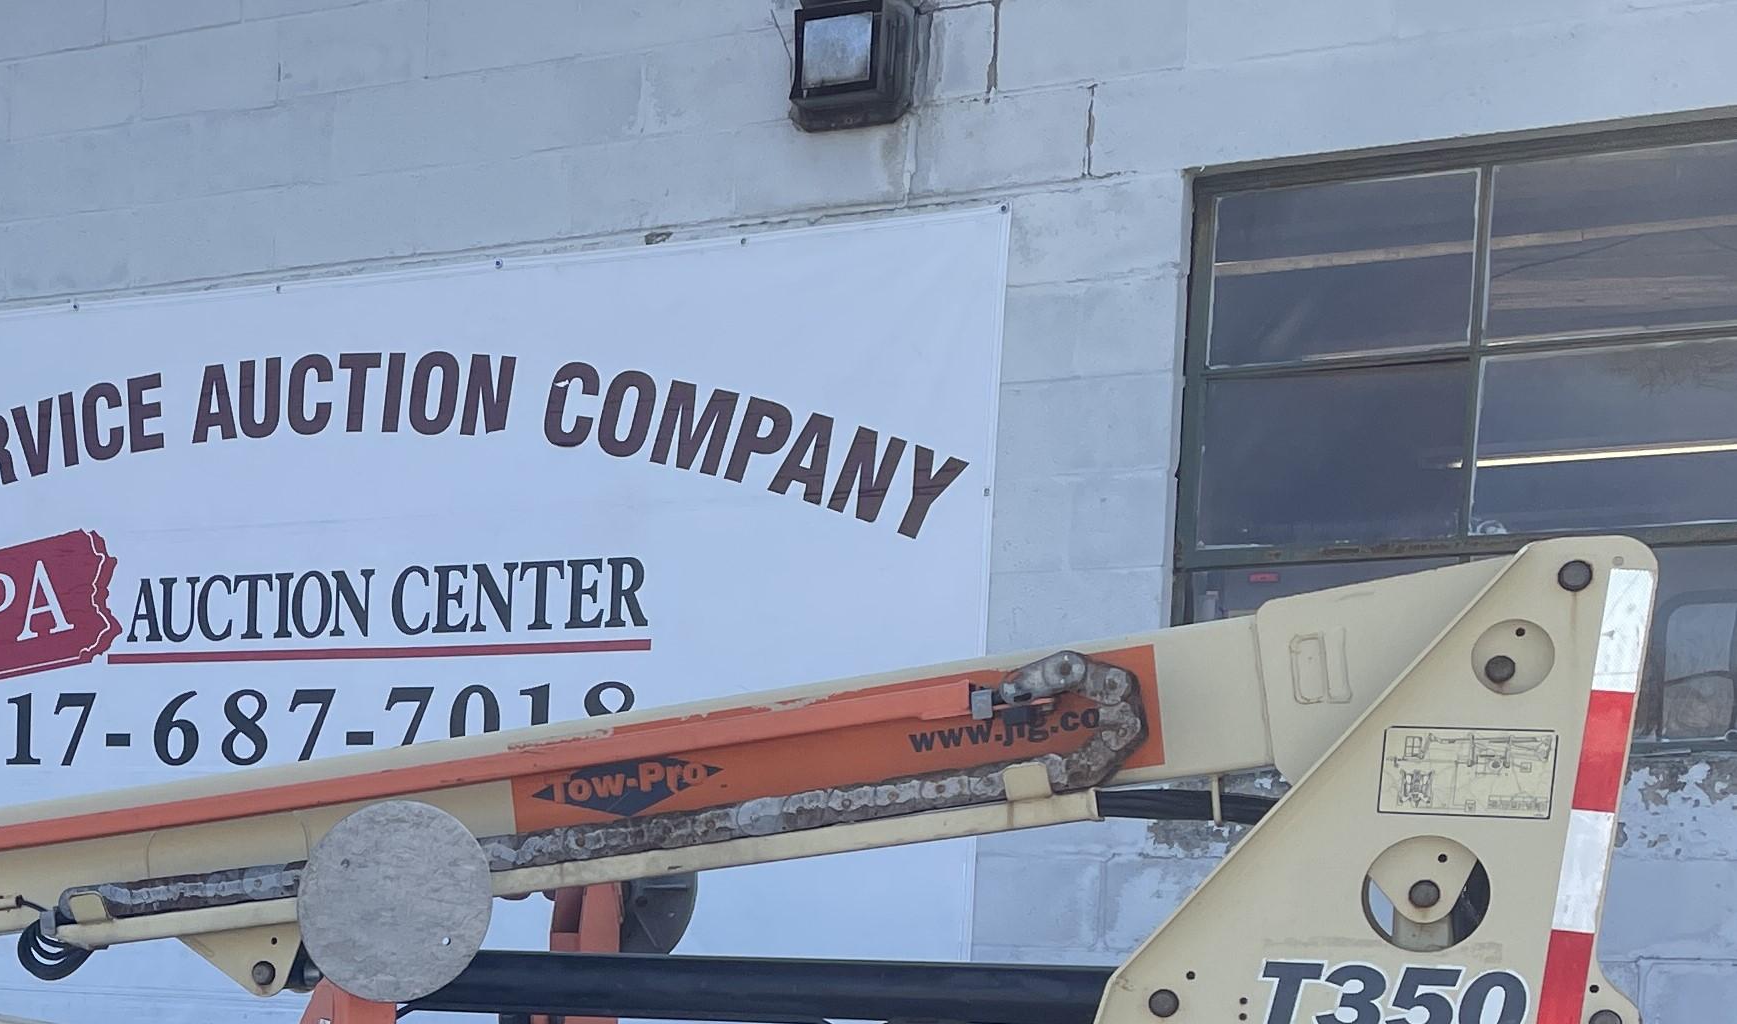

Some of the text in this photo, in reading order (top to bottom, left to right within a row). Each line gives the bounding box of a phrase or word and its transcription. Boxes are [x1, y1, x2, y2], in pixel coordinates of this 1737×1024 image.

[192, 351, 516, 444] AUCTION
[543, 361, 969, 540] COMPANY
[127, 556, 649, 644] AUCTION CENTER
